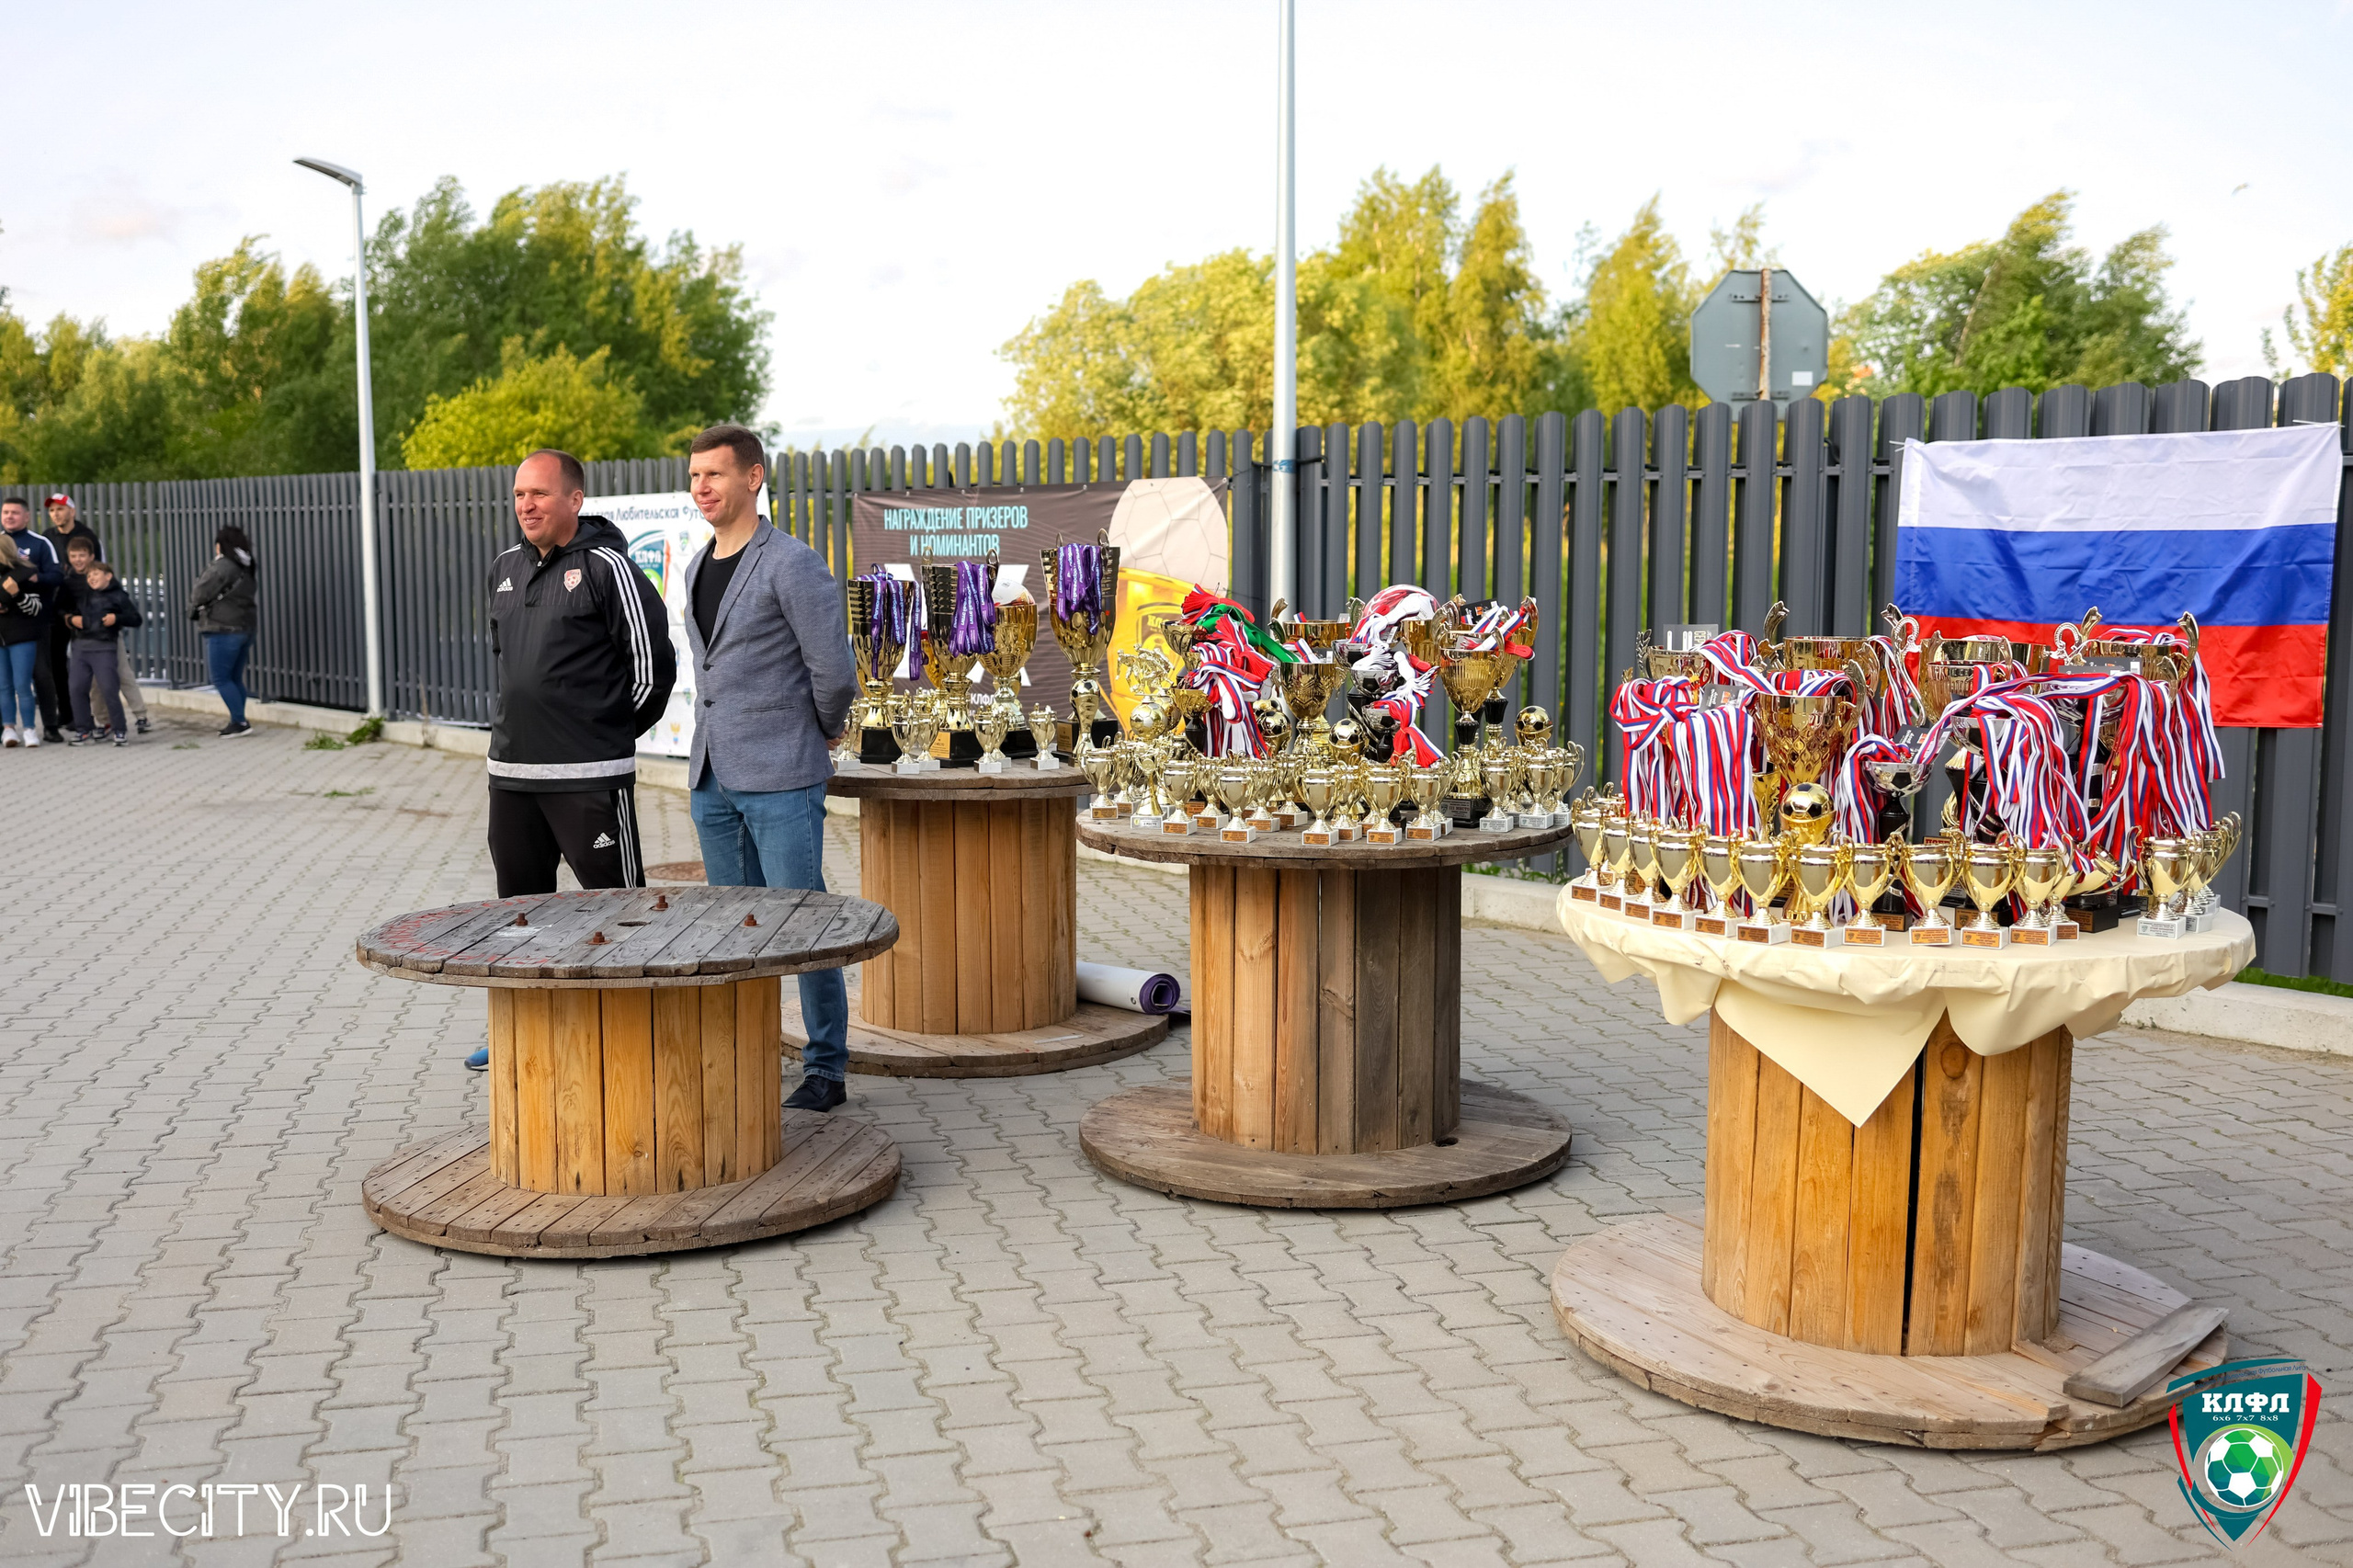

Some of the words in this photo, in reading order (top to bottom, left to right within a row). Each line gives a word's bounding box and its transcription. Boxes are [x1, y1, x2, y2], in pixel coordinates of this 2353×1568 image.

[883, 507, 964, 533] НАГРАЖДЕНИЕ
[966, 506, 1029, 529] ПРИЗЕРОВ
[910, 535, 918, 557] И
[920, 534, 1000, 557] НОМИНАНТОВ
[593, 839, 616, 849] adidas
